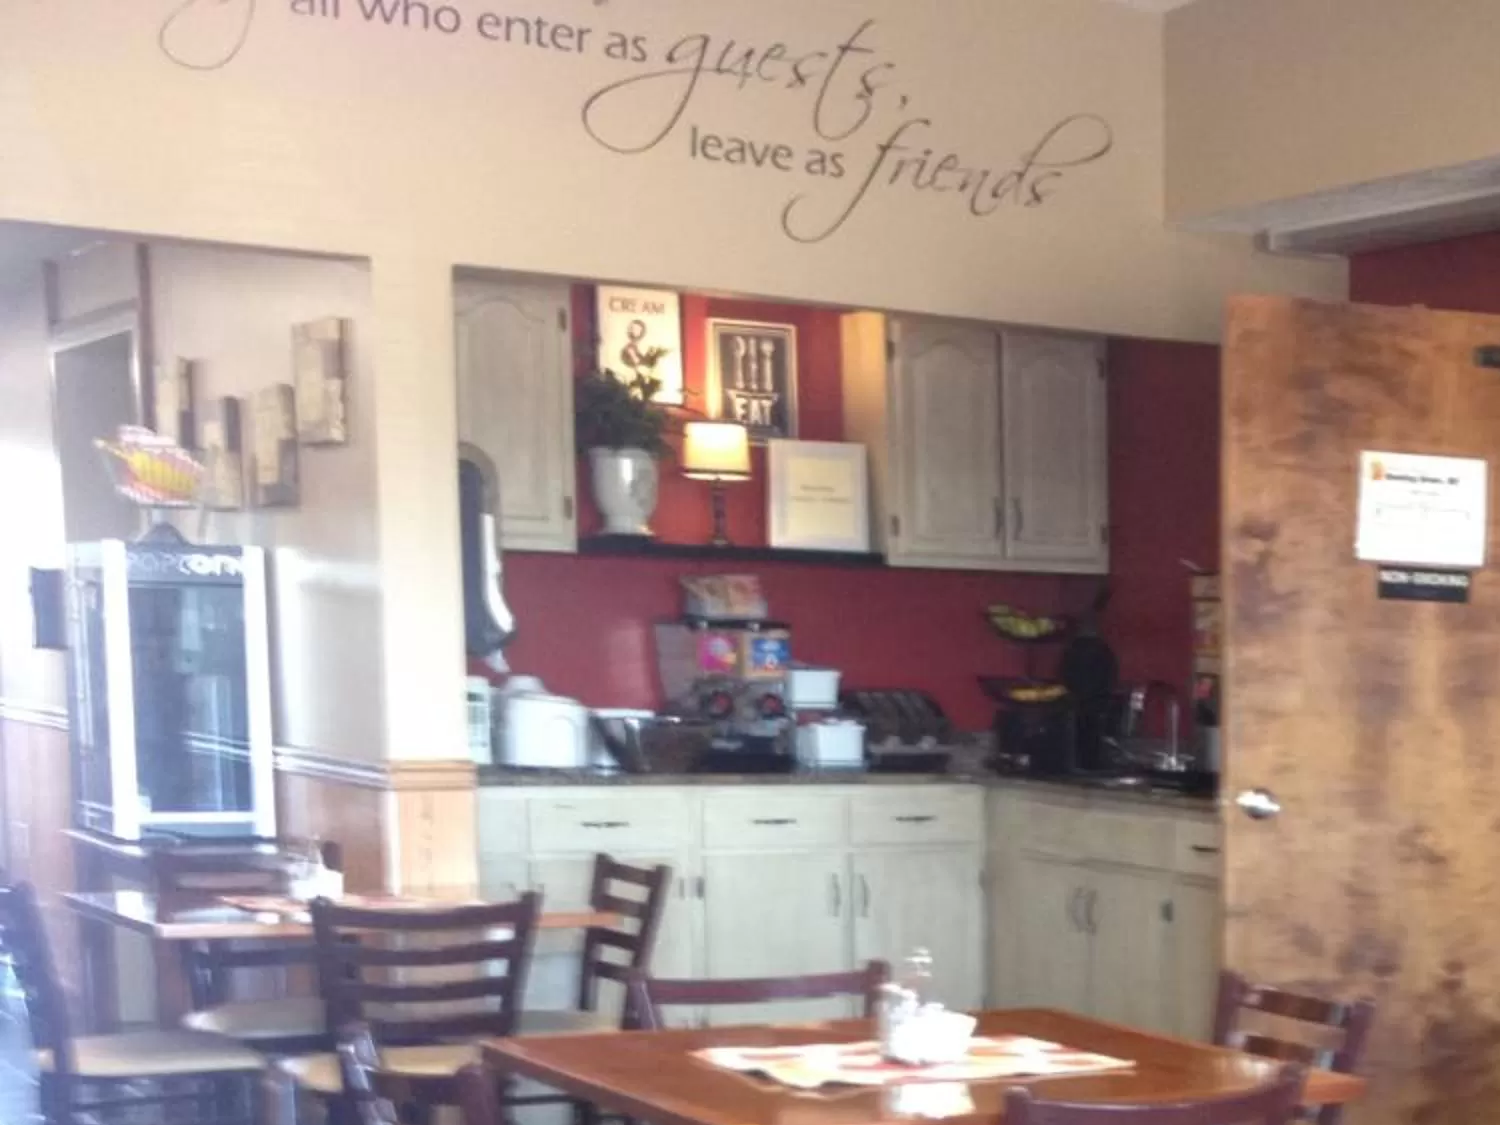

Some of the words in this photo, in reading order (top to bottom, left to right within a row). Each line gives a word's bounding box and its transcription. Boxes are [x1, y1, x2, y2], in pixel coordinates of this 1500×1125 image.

[360, 0, 461, 33] who
[477, 11, 592, 52] enter
[604, 31, 647, 63] as
[689, 125, 794, 171] leave
[804, 149, 846, 178] as
[781, 113, 1112, 243] friends
[608, 296, 665, 314] CREAM
[736, 398, 773, 426] EAT
